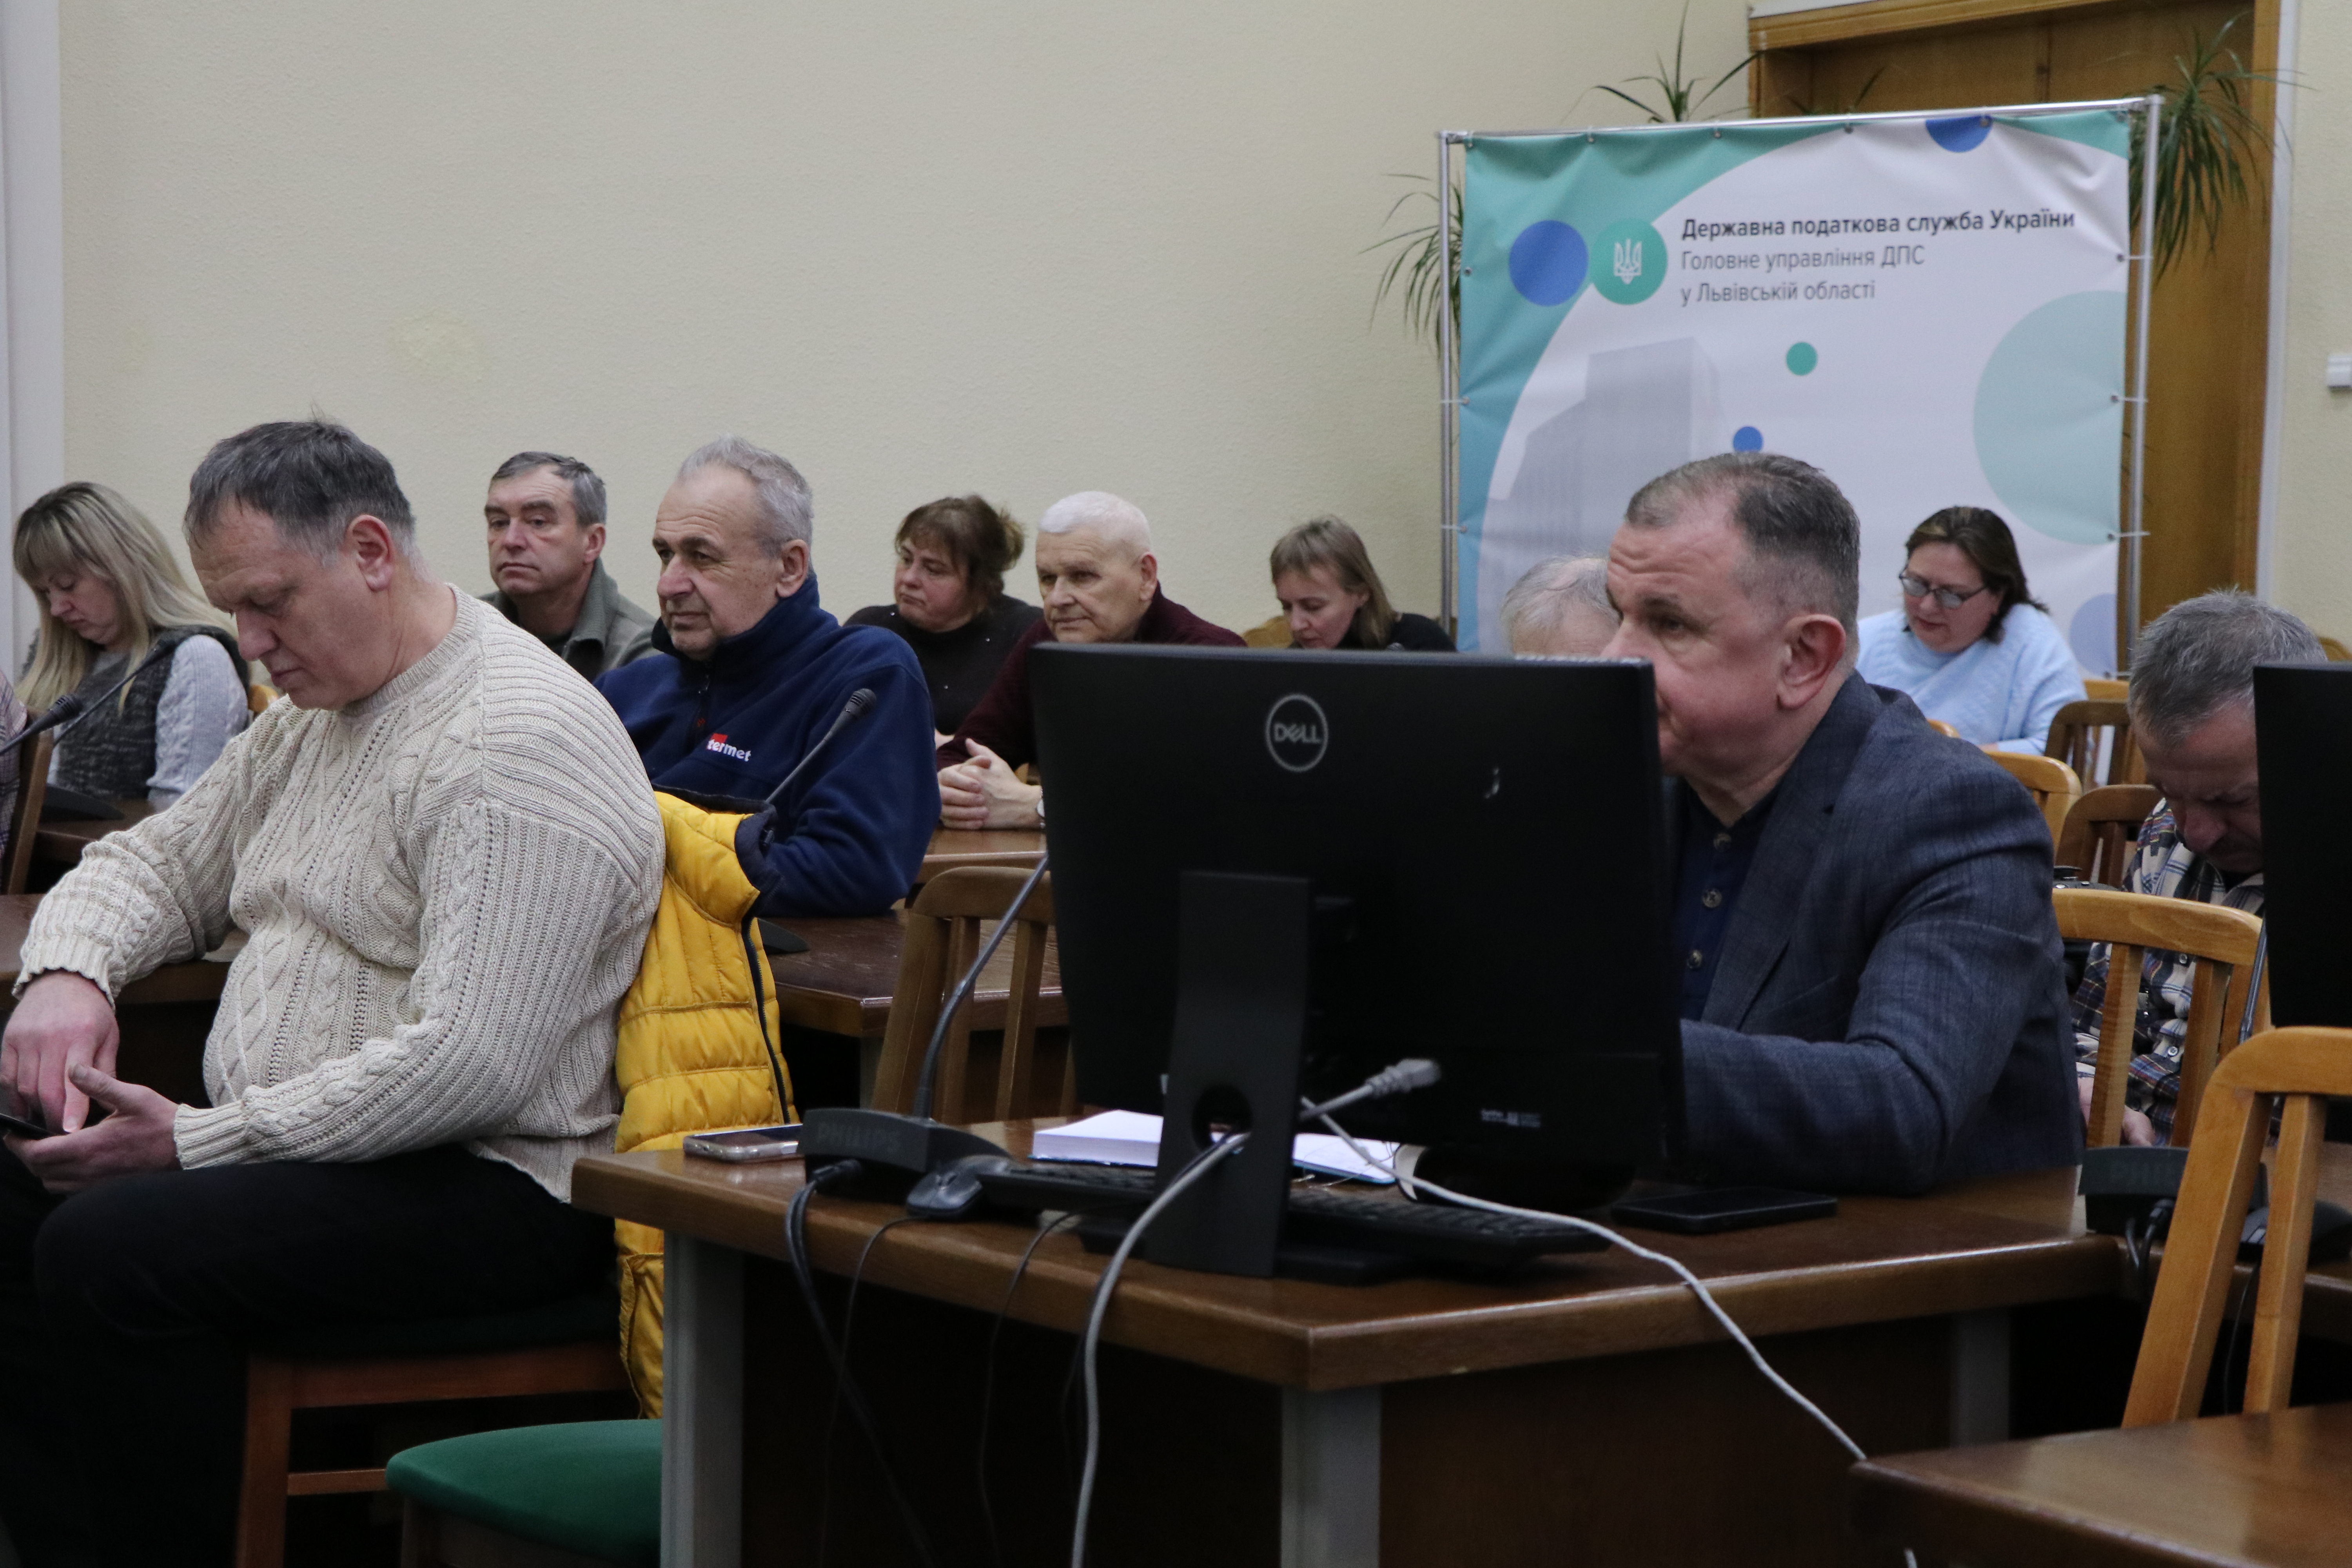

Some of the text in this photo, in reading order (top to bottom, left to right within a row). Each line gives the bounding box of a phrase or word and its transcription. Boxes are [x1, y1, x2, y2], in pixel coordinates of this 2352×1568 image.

[1682, 208, 2075, 241] Державна податкова служба України
[1681, 245, 1925, 273] Головне управління ДПС
[1681, 279, 1875, 307] у Львівській області
[1274, 722, 1323, 744] DELL
[707, 739, 751, 762] termet
